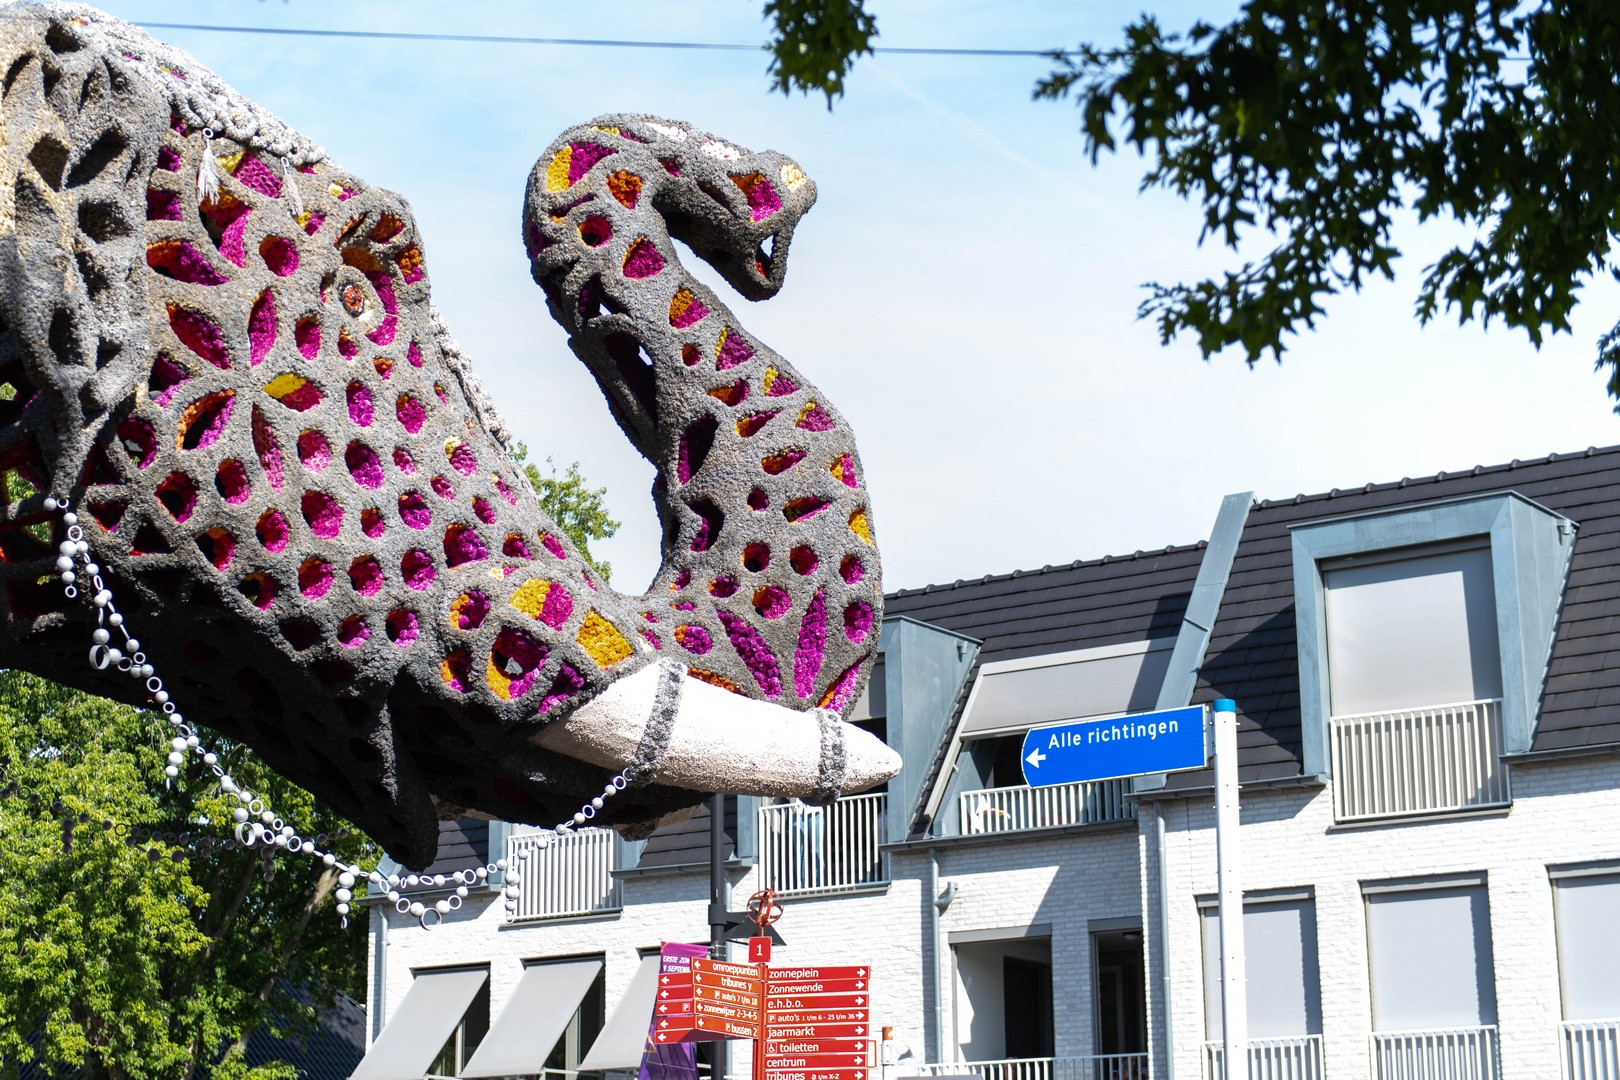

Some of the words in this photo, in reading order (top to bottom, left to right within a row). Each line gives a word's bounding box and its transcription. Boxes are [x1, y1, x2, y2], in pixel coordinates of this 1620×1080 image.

[1048, 732, 1081, 750] Alle
[1088, 720, 1178, 744] richtingen
[756, 944, 763, 956] 1
[712, 963, 758, 976] omroeppunten
[768, 968, 818, 980] zonneplein
[721, 977, 746, 989] tribunes
[748, 983, 752, 992] y
[768, 983, 823, 994] Zonnewende
[768, 999, 804, 1008] e.h.b.o.
[704, 1004, 735, 1016] zonnewijzer
[736, 1009, 758, 1020] 2-3-4-5
[732, 1024, 752, 1036] bussen
[753, 1028, 757, 1036] 2
[767, 1027, 815, 1038] jaarmarkt
[780, 1043, 819, 1052] toiletten
[766, 1058, 806, 1067] centrum
